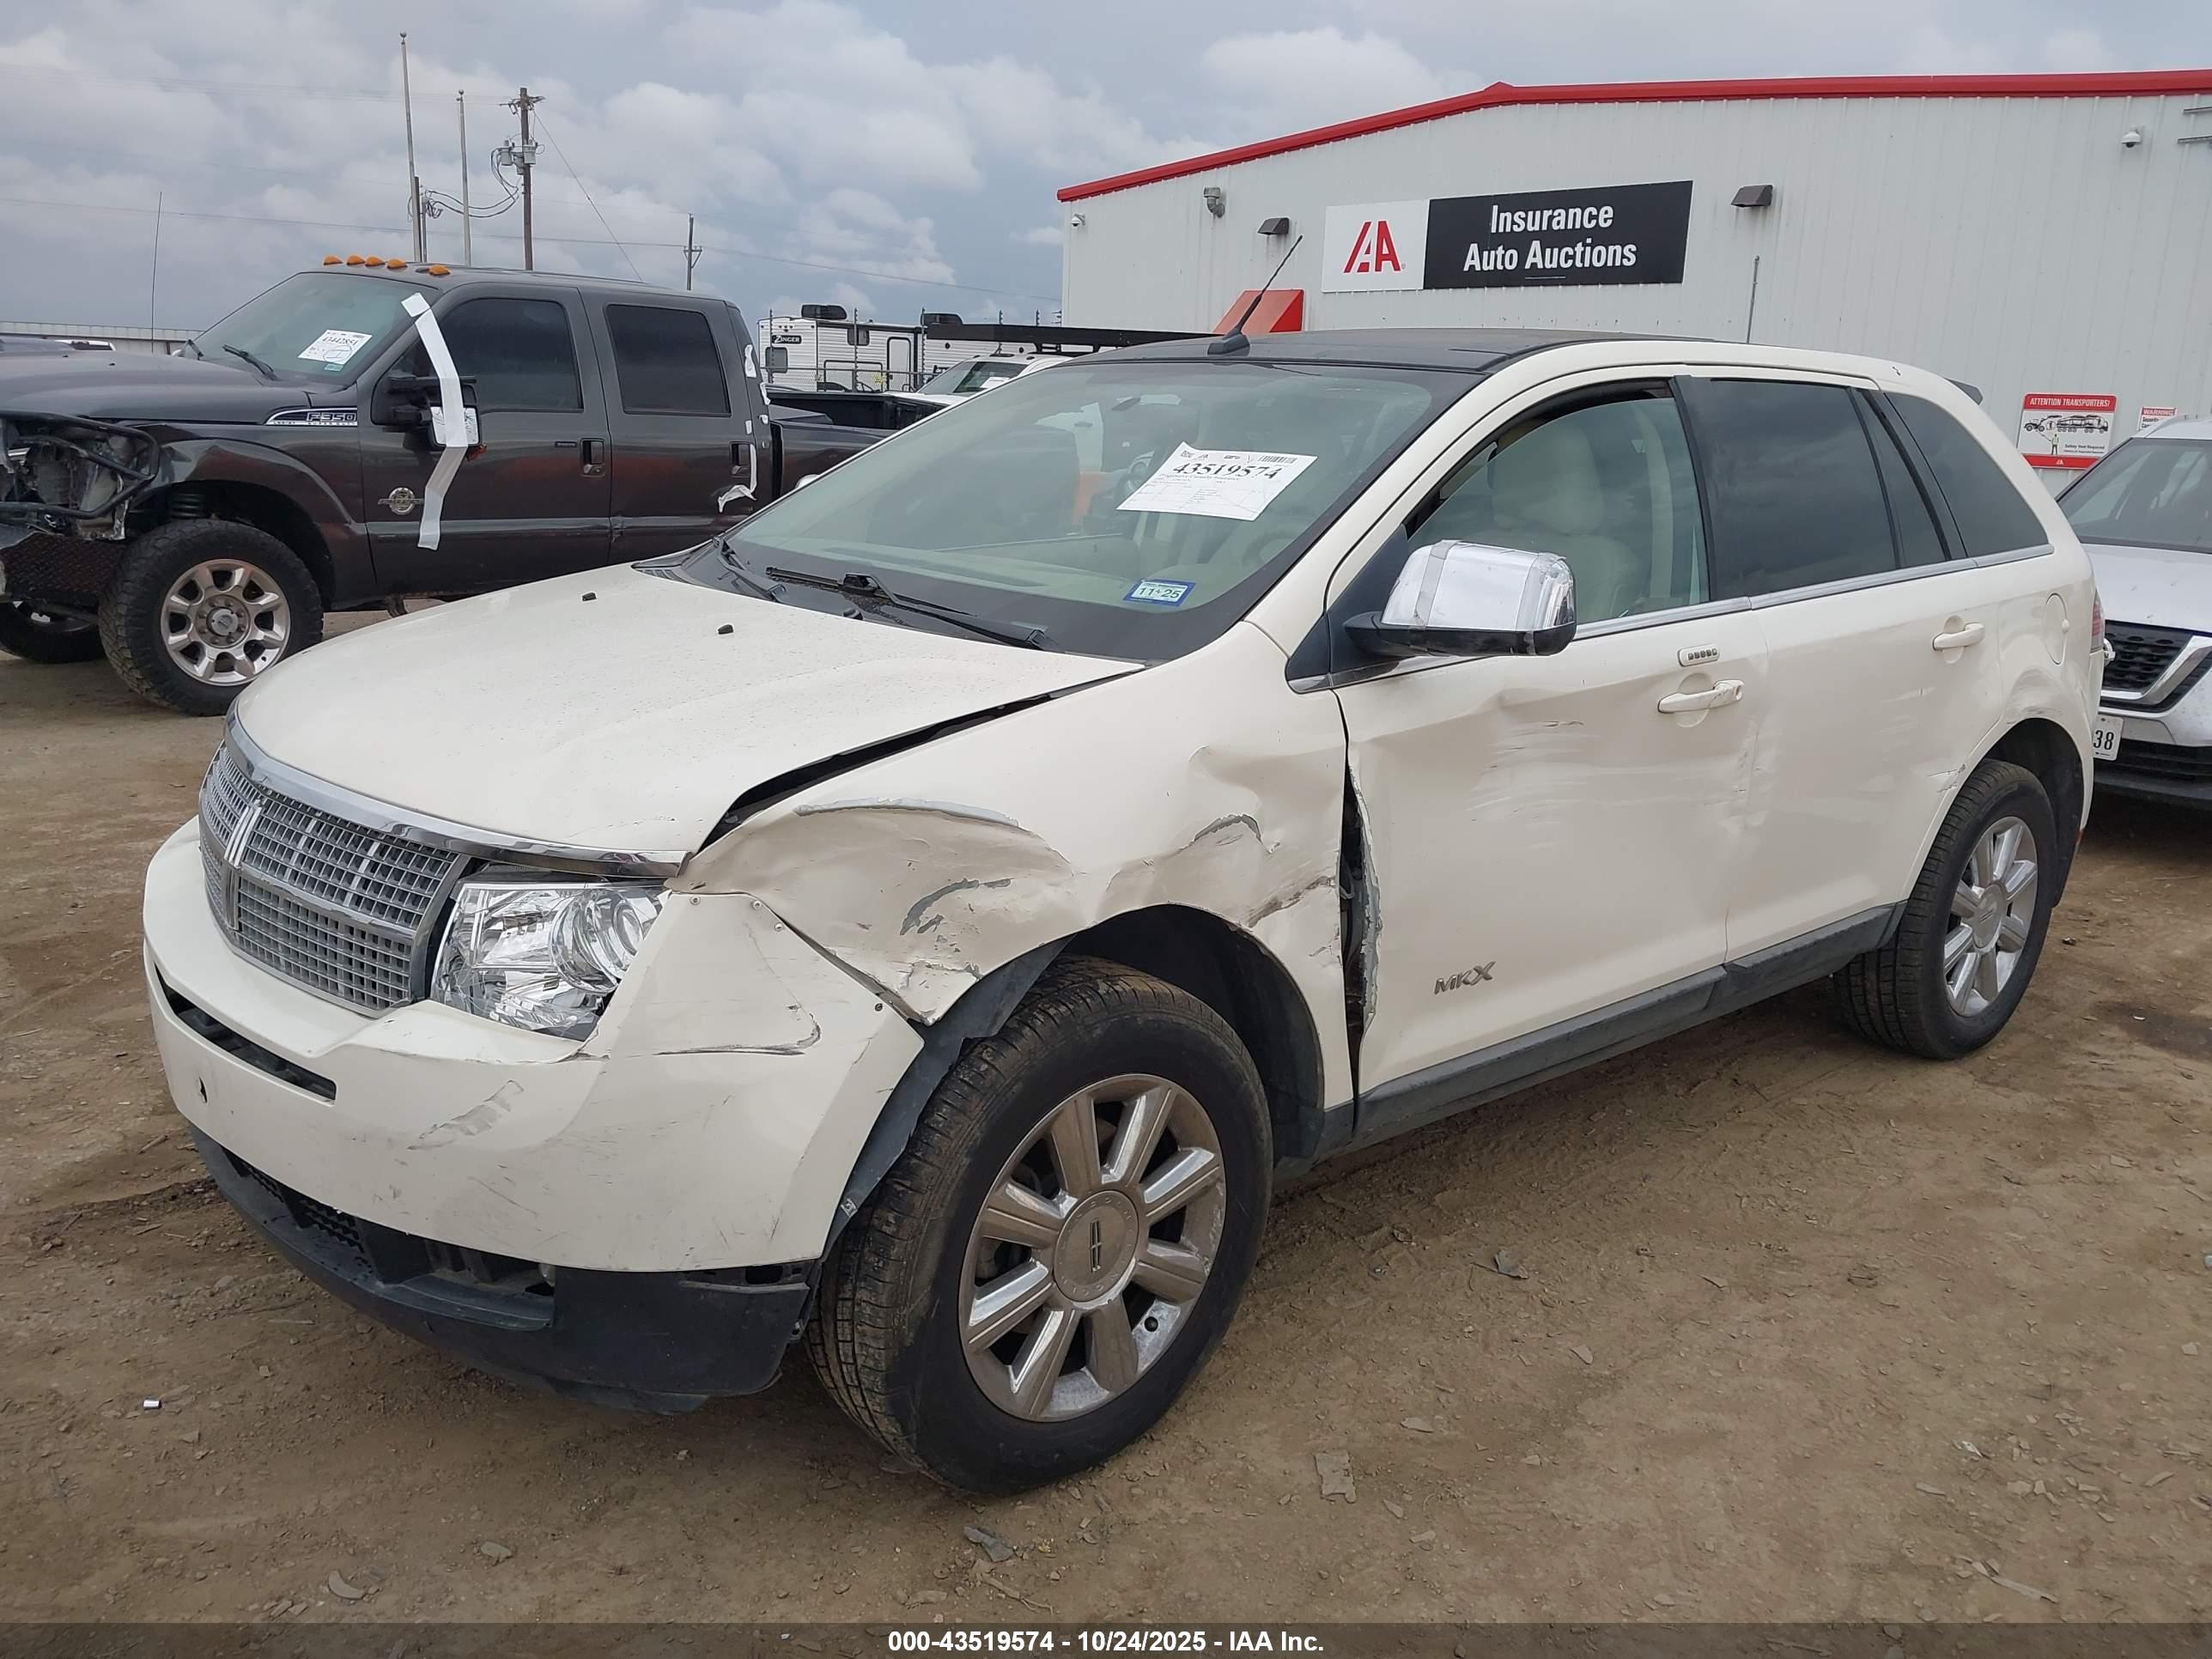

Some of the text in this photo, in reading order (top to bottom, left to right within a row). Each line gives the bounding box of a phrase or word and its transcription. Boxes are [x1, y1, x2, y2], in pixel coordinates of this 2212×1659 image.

[1490, 204, 1613, 234] Insurance
[1463, 238, 1638, 271] Auto Auctions
[774, 335, 800, 343] ZINGER
[2029, 398, 2110, 407] ATTENTION TRANSPORTERS!
[1173, 463, 1283, 479] 43519574
[1160, 588, 1182, 599] 25
[1434, 961, 1497, 995] MKX
